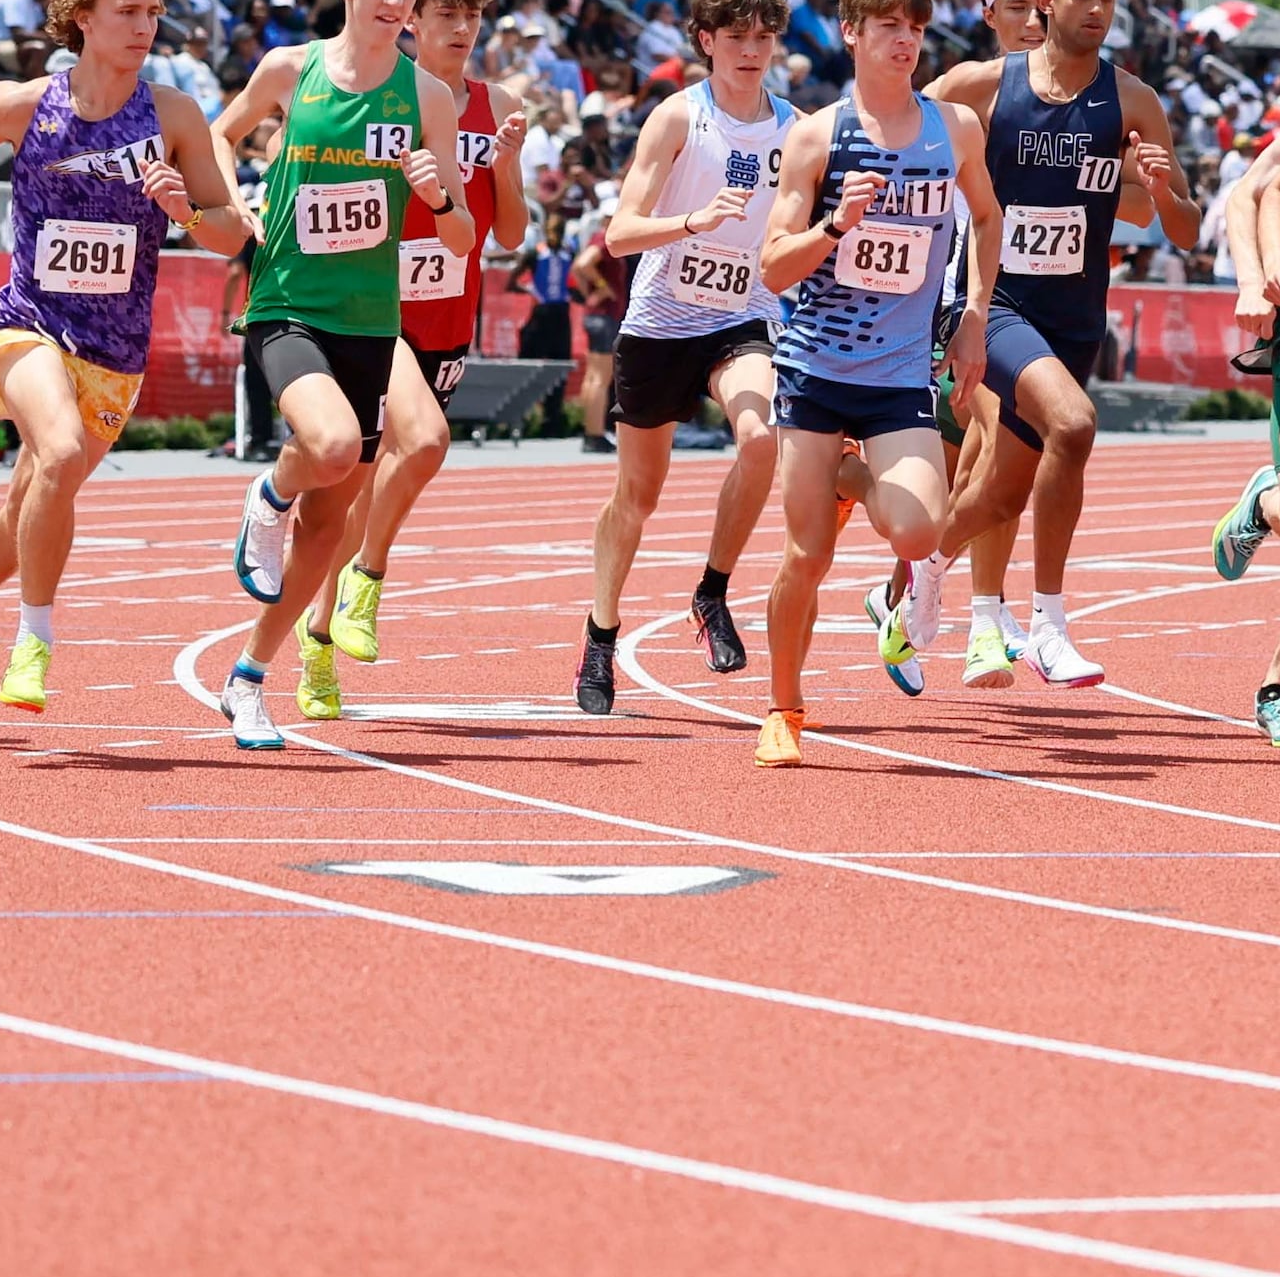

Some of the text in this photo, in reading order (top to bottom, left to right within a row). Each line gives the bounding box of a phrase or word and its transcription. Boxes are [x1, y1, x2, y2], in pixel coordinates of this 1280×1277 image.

[122, 139, 160, 179] 14
[287, 145, 317, 163] THE
[371, 126, 405, 159] 13
[459, 133, 490, 165] 12
[1018, 130, 1093, 167] PACE
[769, 148, 783, 188] 9
[1085, 158, 1115, 190] 10
[917, 181, 948, 214] 11
[308, 198, 382, 234] 1158
[48, 239, 126, 274] 2691
[855, 239, 910, 274] 831
[1010, 224, 1082, 256] 4273
[410, 255, 445, 284] 73
[679, 255, 751, 295] 5238
